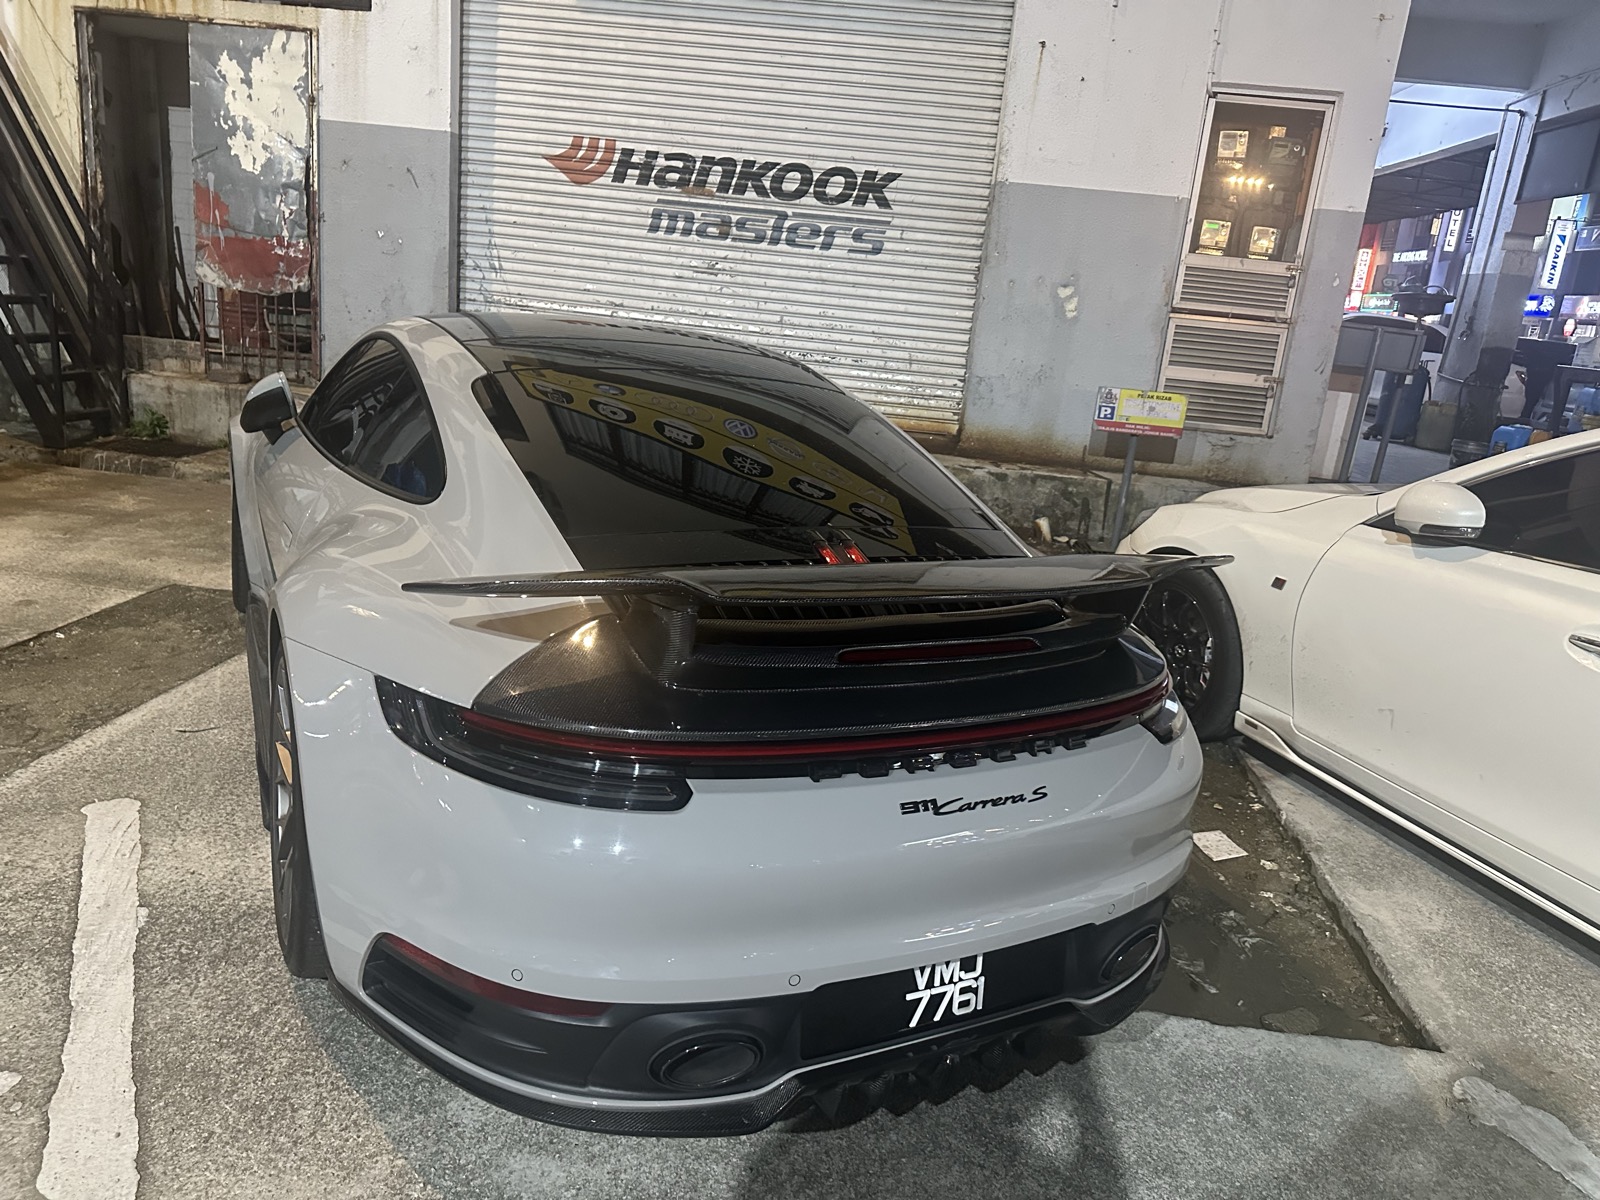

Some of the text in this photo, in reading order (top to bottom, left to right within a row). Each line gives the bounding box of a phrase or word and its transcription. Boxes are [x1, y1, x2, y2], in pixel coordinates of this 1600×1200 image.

[647, 207, 889, 256] masters
[1546, 245, 1562, 284] DAIKIN
[1100, 406, 1112, 418] P
[900, 785, 1048, 816] 911 Carrera S
[913, 953, 983, 990] VMJ
[905, 976, 985, 1028] 7761
